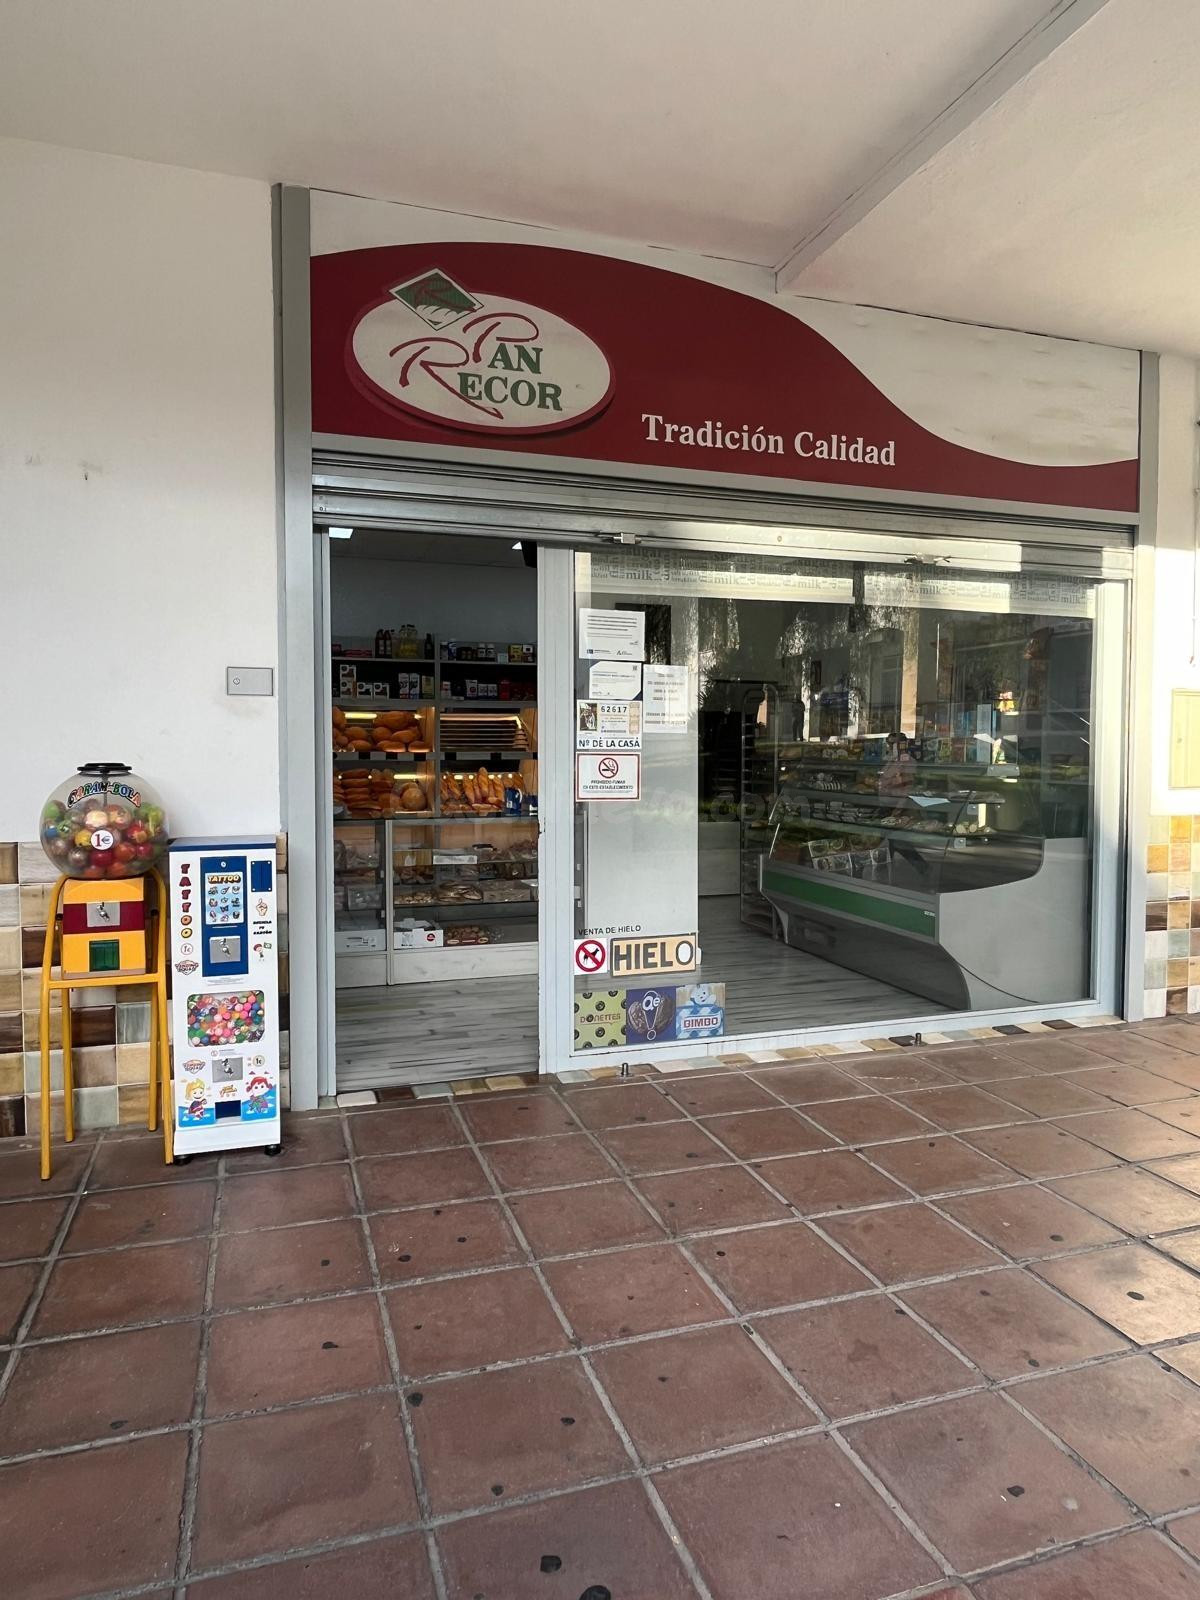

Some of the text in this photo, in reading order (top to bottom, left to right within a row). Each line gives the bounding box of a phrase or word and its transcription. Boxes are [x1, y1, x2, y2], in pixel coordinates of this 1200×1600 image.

[462, 312, 543, 375] PAN
[389, 337, 563, 419] RECOR
[641, 413, 896, 466] Tradición Calidad
[626, 570, 652, 581] milk
[713, 574, 740, 585] milk
[798, 579, 822, 590] milk
[600, 705, 628, 713] 62617
[578, 739, 640, 748] Nº DE LA CASA
[93, 833, 111, 848] 1€
[208, 874, 242, 885] TATTOO
[578, 925, 641, 936] VENTA DE HIELO
[613, 940, 694, 972] HIELO
[683, 1016, 719, 1029] BIMBO
